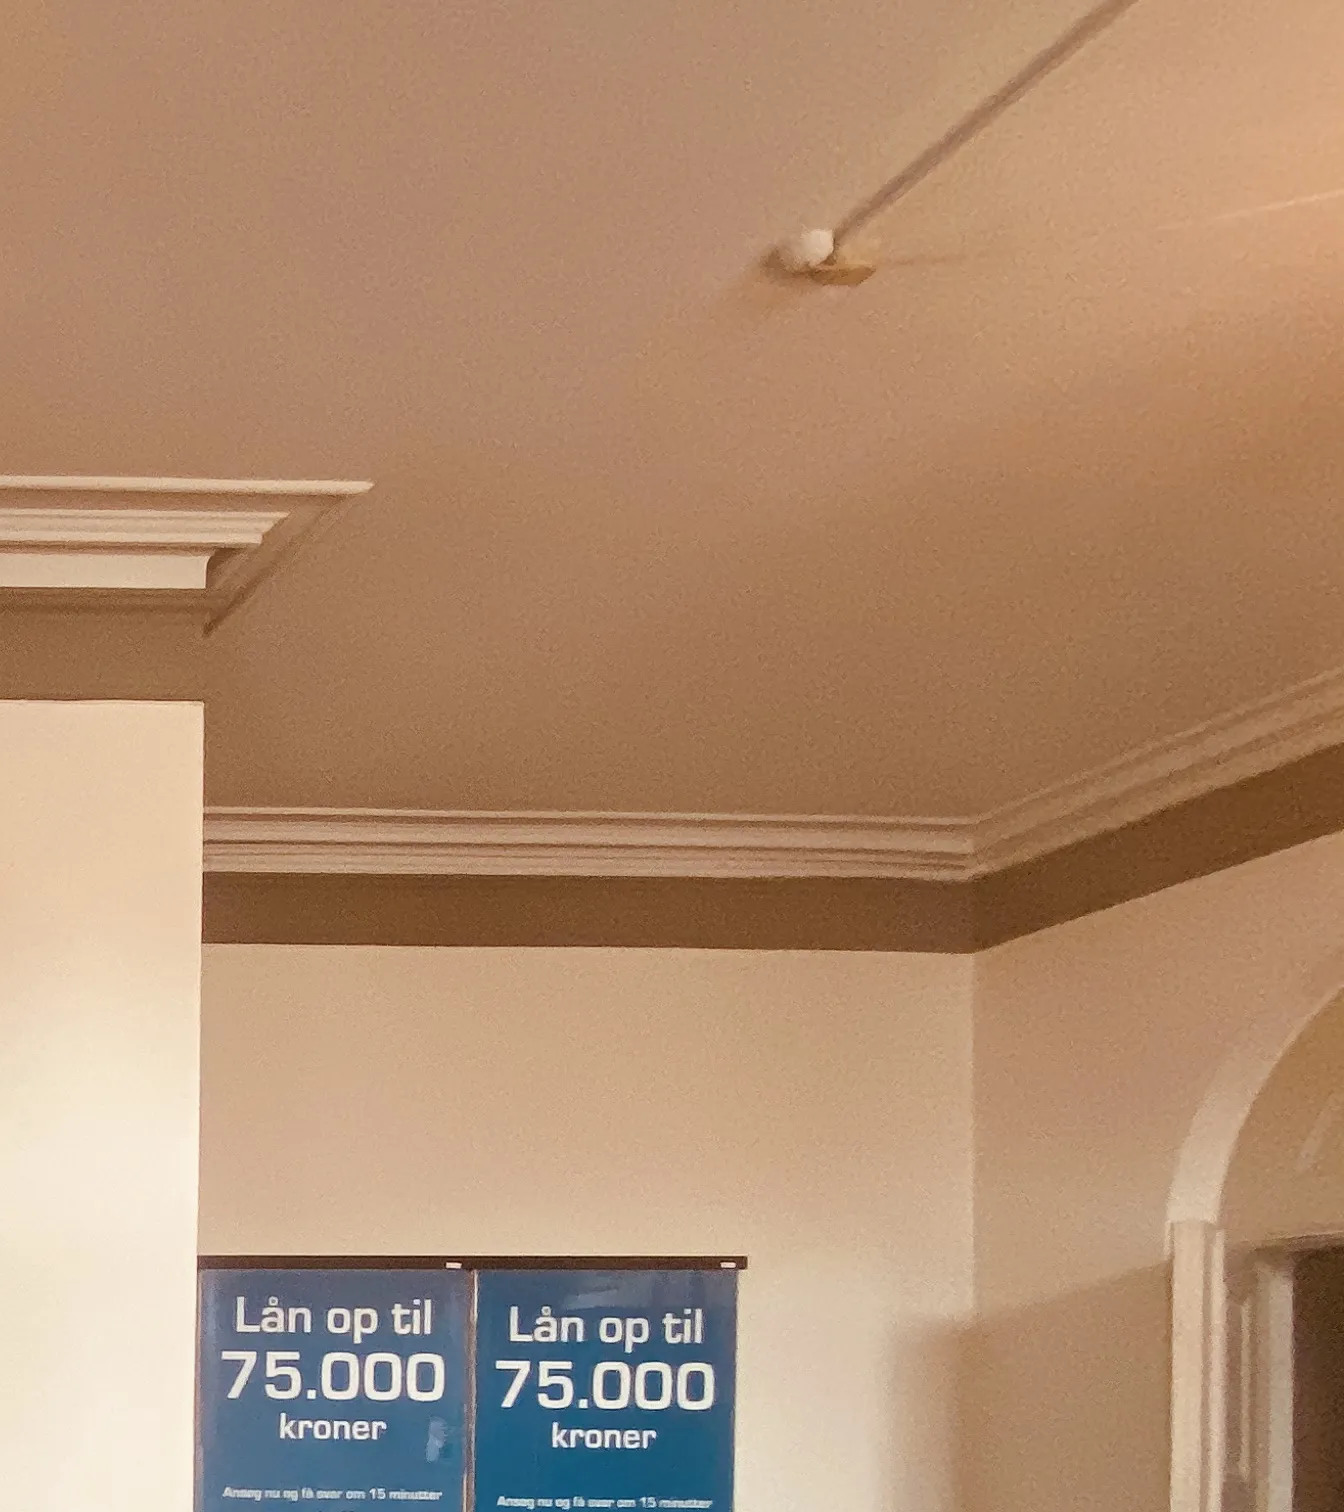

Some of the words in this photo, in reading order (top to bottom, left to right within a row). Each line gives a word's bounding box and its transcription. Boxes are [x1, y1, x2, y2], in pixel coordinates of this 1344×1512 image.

[236, 1296, 312, 1334] Lån
[326, 1306, 379, 1344] op
[391, 1298, 433, 1335] til
[509, 1305, 585, 1343] Lån
[599, 1316, 650, 1354] op
[662, 1308, 704, 1345] til
[220, 1350, 446, 1402] 75.000
[495, 1360, 715, 1411] 75.000
[279, 1412, 388, 1441] kroner
[551, 1421, 658, 1450] kroner
[264, 1489, 281, 1499] nu
[282, 1489, 299, 1502] og
[345, 1489, 366, 1500] om
[369, 1487, 387, 1500] 15
[554, 1498, 571, 1511] og
[639, 1496, 658, 1509] 15
